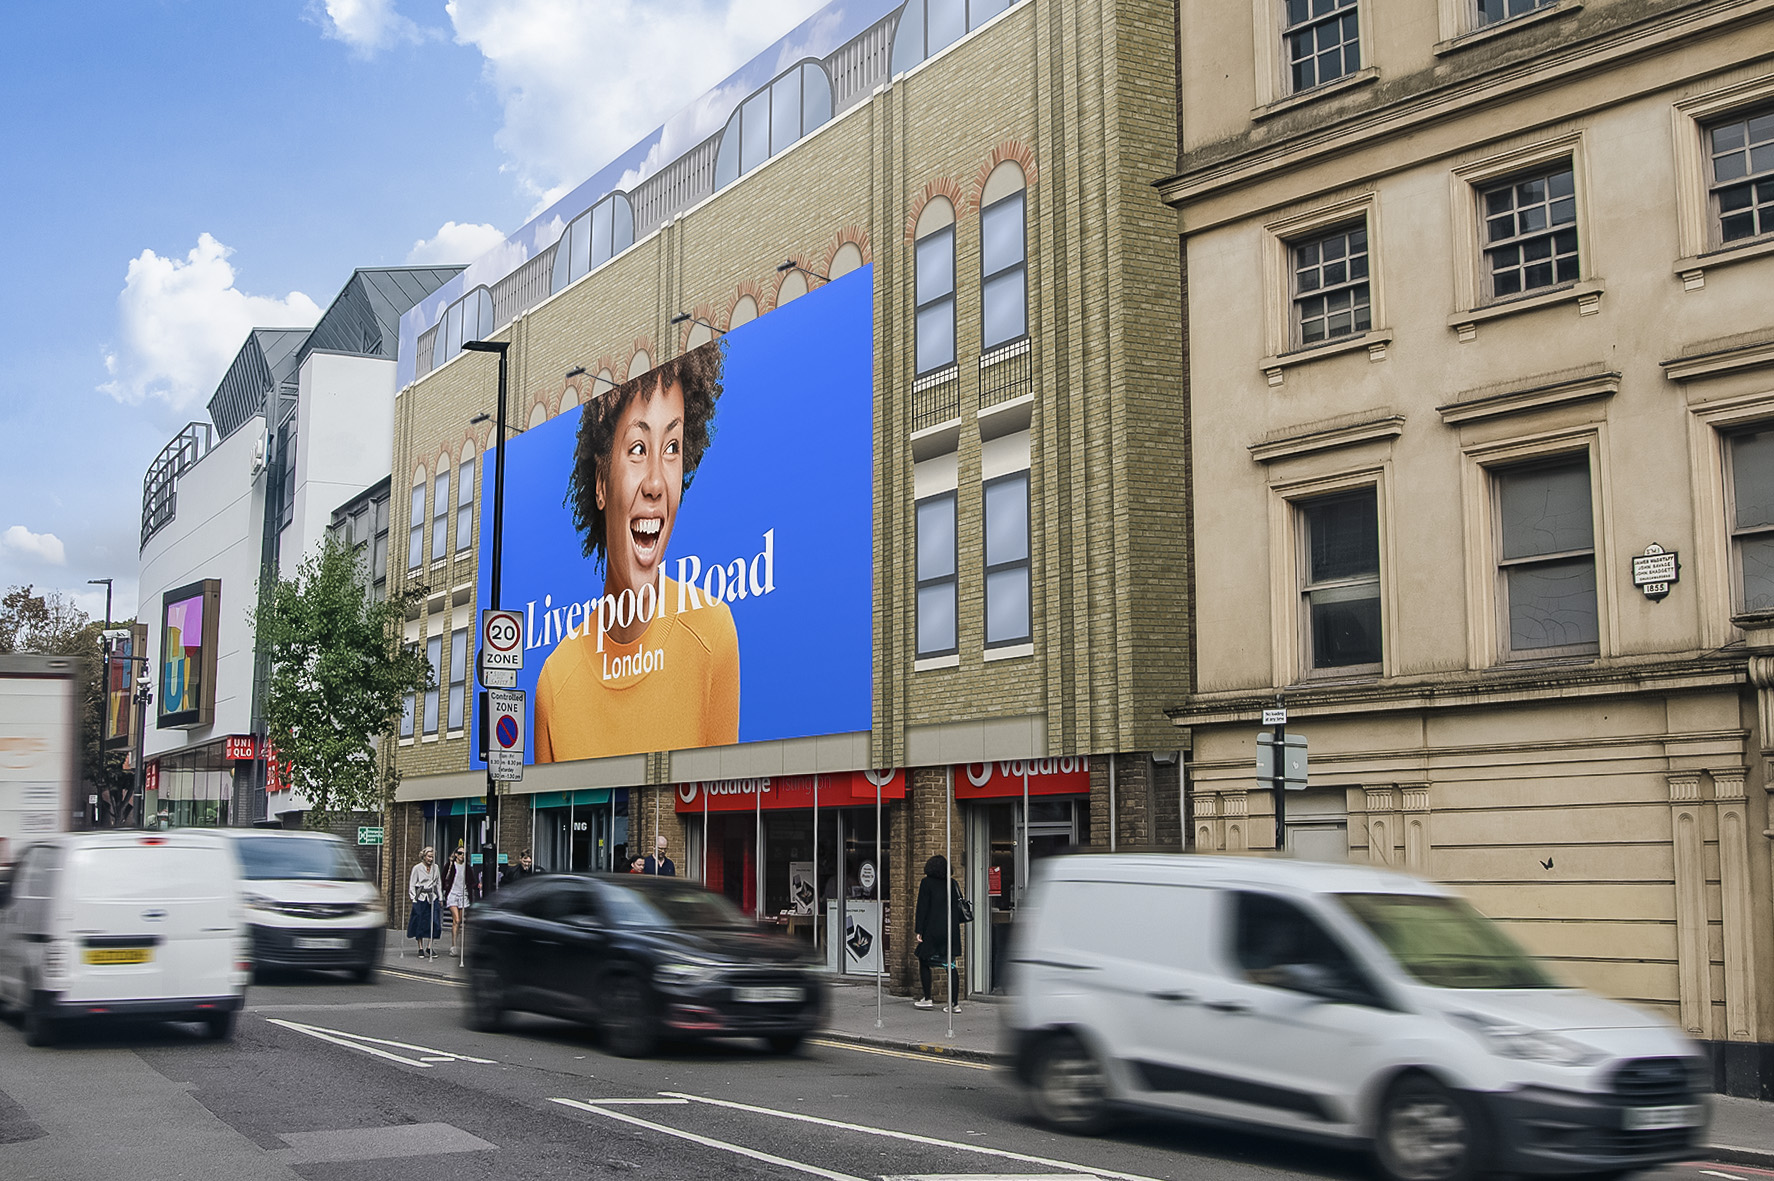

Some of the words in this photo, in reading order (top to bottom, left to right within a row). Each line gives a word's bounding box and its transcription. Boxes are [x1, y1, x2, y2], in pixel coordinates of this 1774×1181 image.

[525, 559, 668, 654] Liverpool
[676, 528, 776, 616] Road
[1646, 583, 1665, 593] 1855
[491, 625, 515, 641] 20
[487, 653, 518, 665] ZONE
[602, 644, 664, 681] London
[490, 692, 523, 702] Controlled
[496, 702, 518, 713] ZONE
[233, 738, 251, 748] UNI
[233, 748, 252, 758] QLO
[782, 775, 831, 795] Islingon
